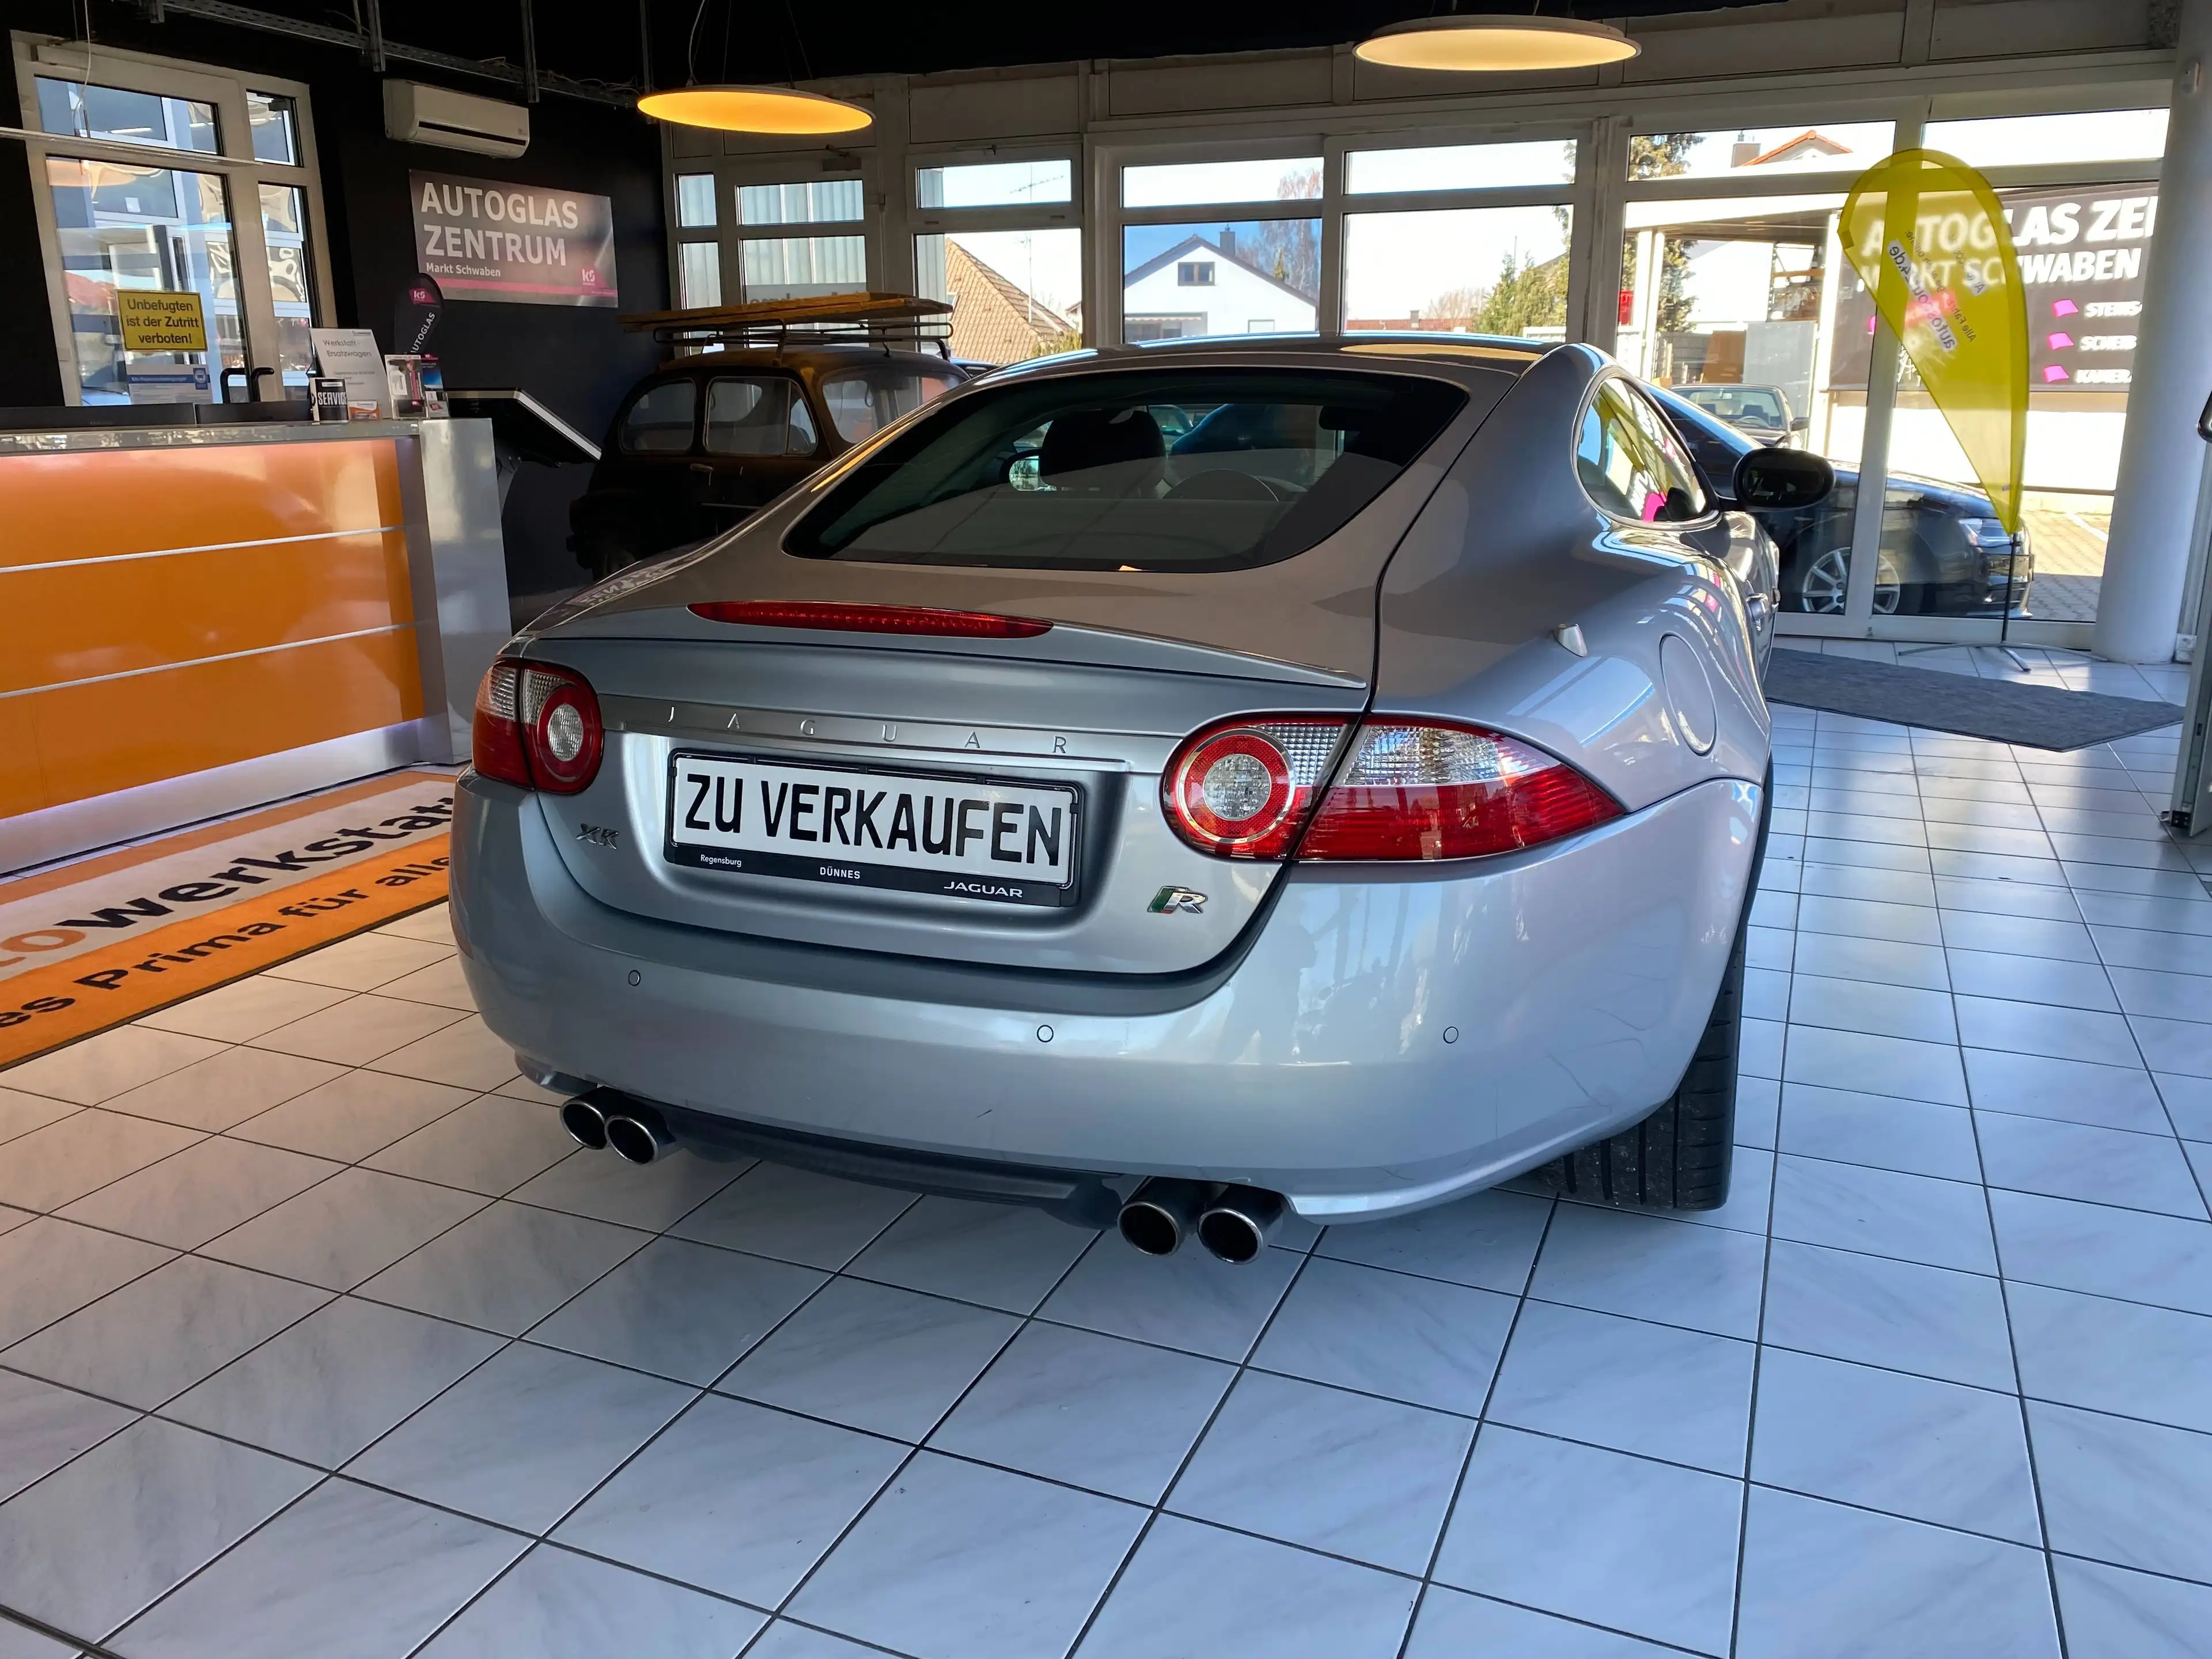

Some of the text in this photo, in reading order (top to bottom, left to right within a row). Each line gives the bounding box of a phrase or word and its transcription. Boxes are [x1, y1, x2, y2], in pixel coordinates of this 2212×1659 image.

[421, 182, 578, 229] AUTOGLAS
[1861, 202, 2081, 257] ATOGLAS
[425, 224, 567, 266] ZENTRUM
[426, 262, 501, 278] Markt Schwaben
[127, 298, 193, 313] Unbefugten
[126, 316, 199, 328] ist der Zutritt
[138, 333, 192, 344] verboten!
[668, 706, 1067, 753] JAGUAR
[685, 773, 1062, 866] ZU VERKAUFEN
[700, 855, 742, 868] Regensburg
[820, 865, 861, 880] DÜNNES
[0, 797, 453, 967] owerkstat
[943, 881, 1023, 898] JAGUAR
[73, 922, 287, 990] Prima
[278, 889, 369, 918] für
